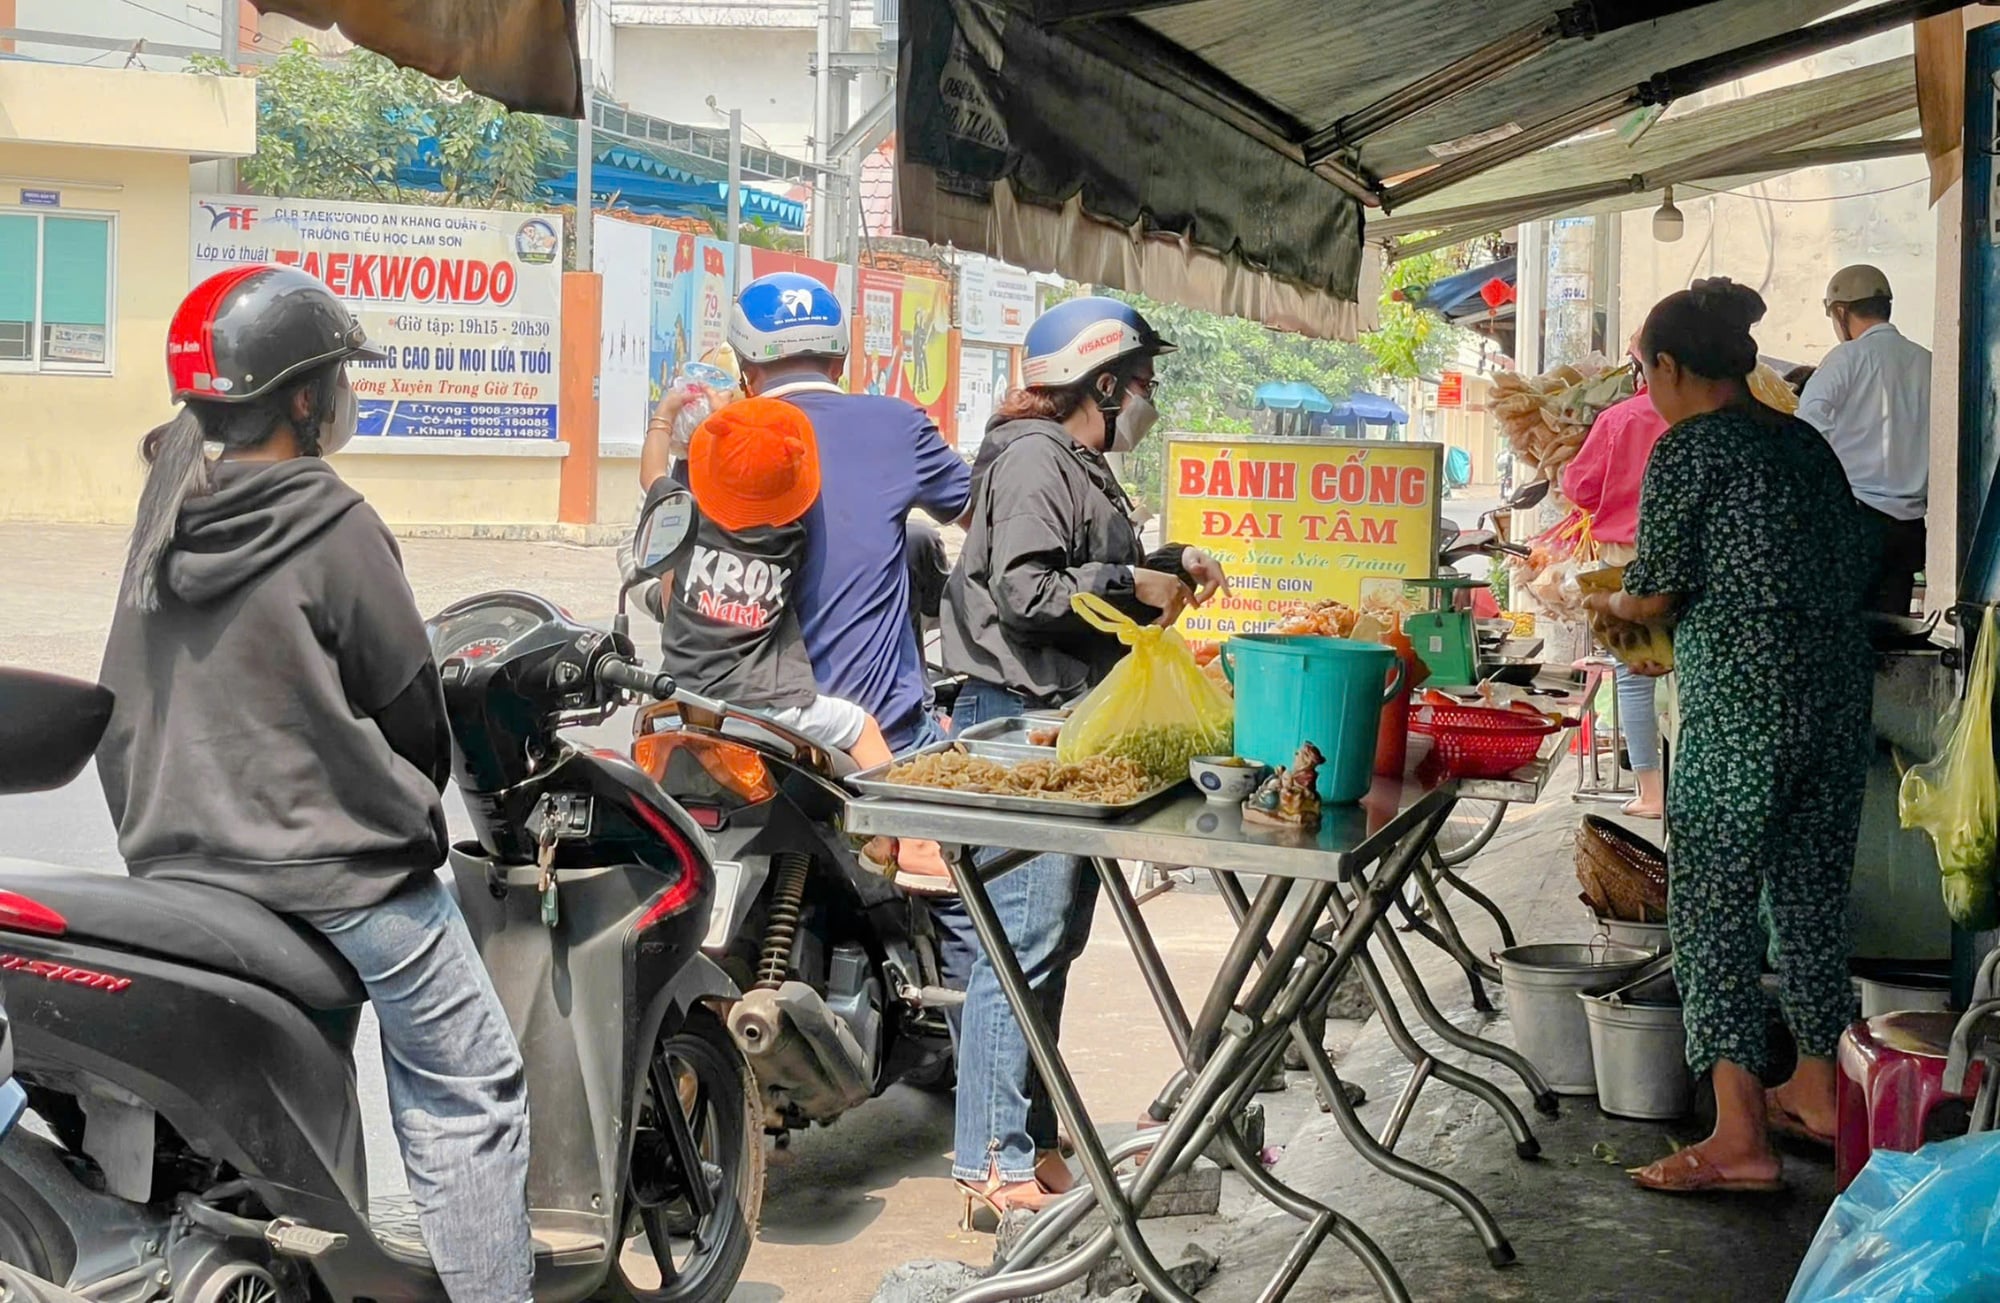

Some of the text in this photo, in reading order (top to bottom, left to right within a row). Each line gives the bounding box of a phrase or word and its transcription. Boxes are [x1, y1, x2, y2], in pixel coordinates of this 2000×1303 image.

[303, 210, 379, 225] TAEKWONDO
[382, 214, 398, 226] AN
[401, 215, 441, 229] KHANG
[411, 234, 435, 246] LAM
[397, 315, 422, 331] Giờ
[427, 317, 454, 336] tập:
[460, 319, 498, 335] 19h15
[511, 321, 550, 336] 20h30
[402, 346, 430, 371] CAO
[435, 341, 454, 371] ĐỦ
[459, 348, 486, 377] MỌI
[491, 345, 516, 373] LỨA
[439, 380, 479, 398] Trong
[1178, 449, 1426, 505] BÁNH CỐNG
[1202, 509, 1399, 544] ĐẠI TÂM
[1226, 574, 1271, 589] CHIÊN
